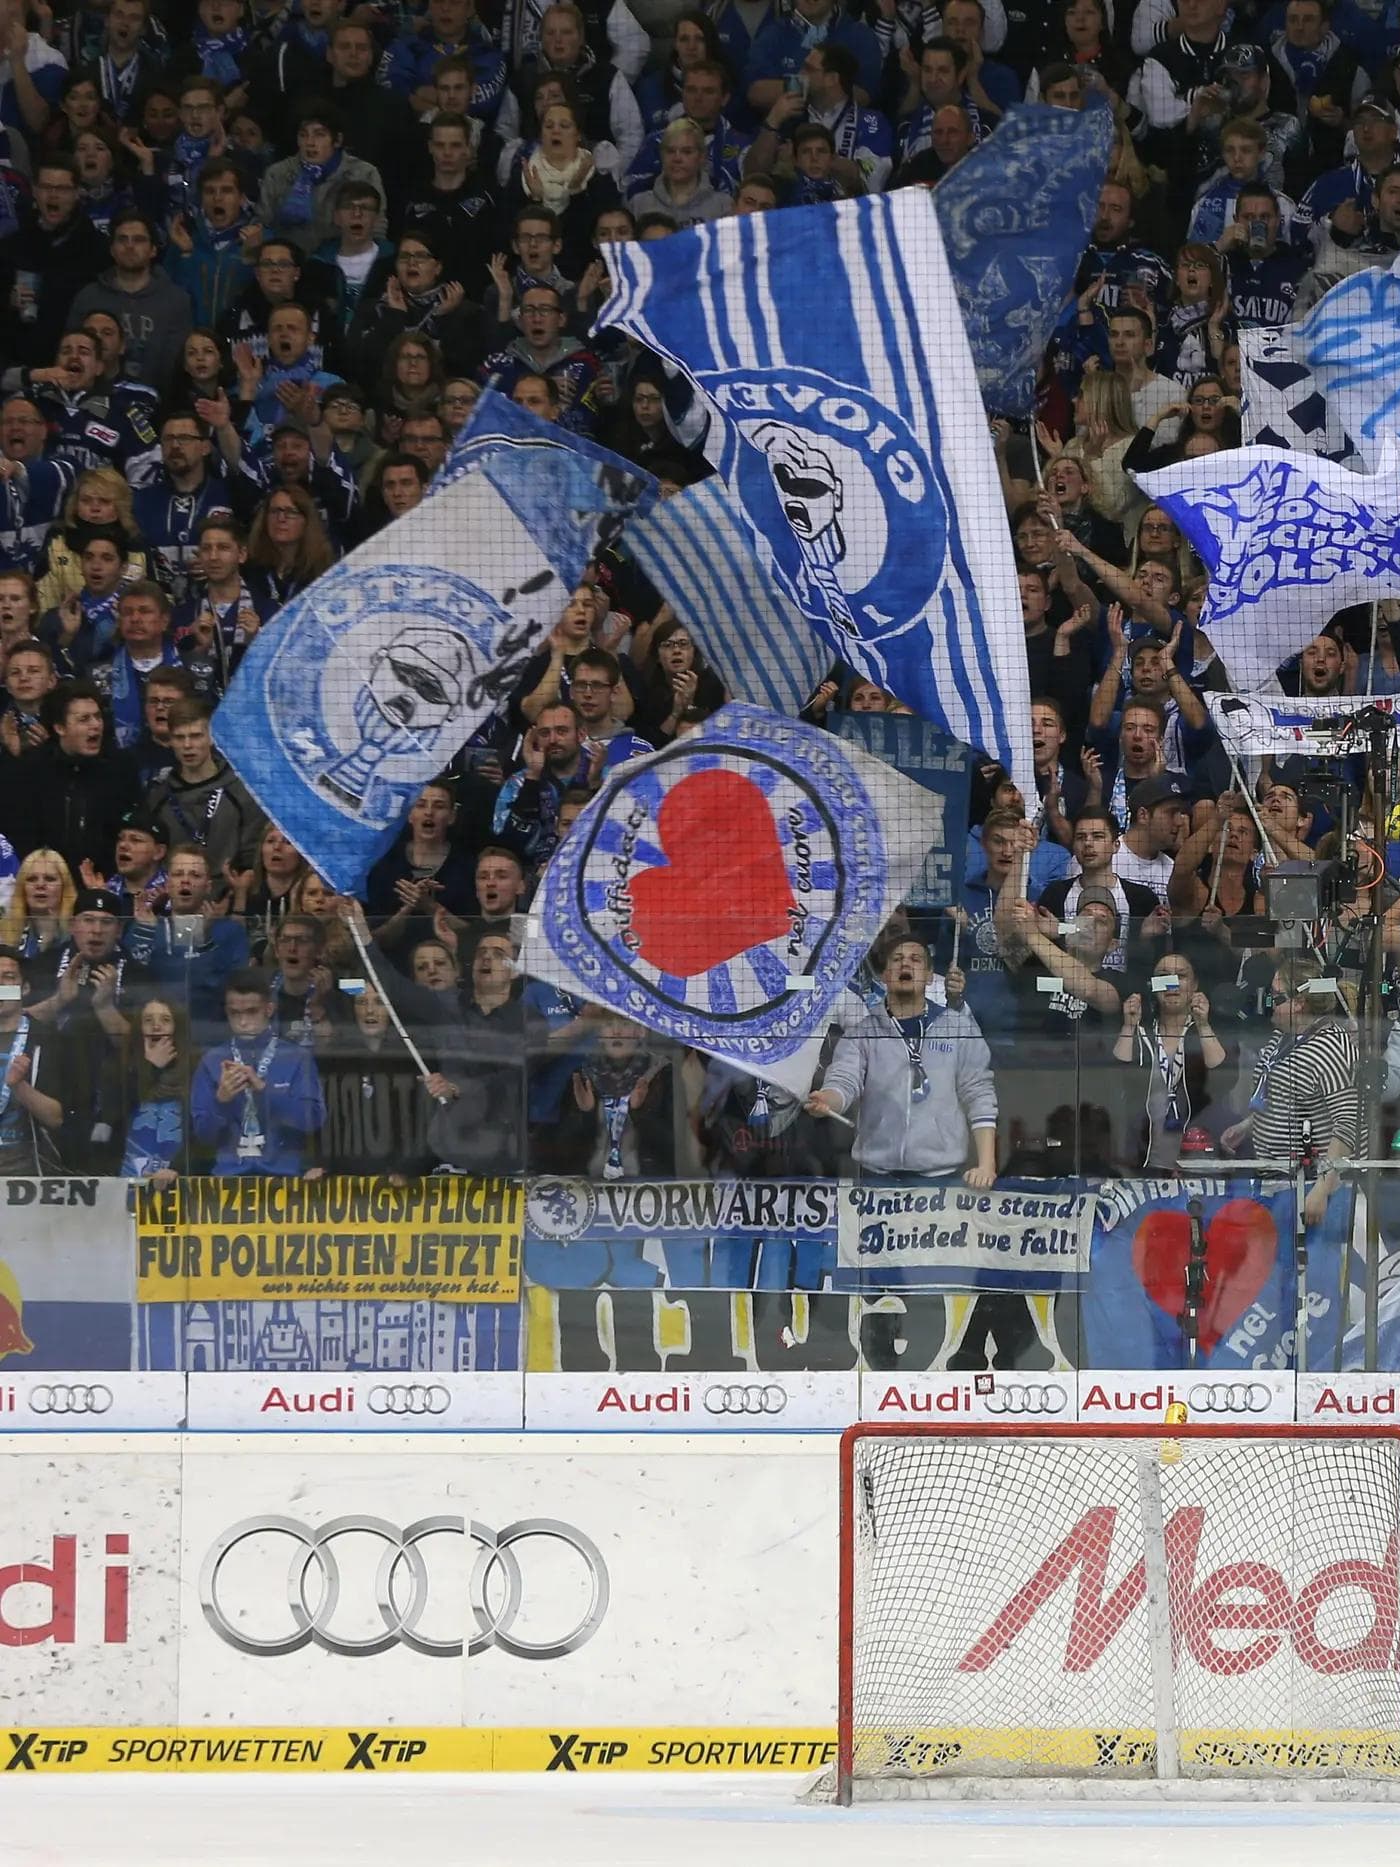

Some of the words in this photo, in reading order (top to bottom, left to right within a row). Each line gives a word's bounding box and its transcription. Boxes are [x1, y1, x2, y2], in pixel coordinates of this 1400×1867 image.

[139, 1175, 524, 1225] KENNZEICHNUNGSPFLICHT
[849, 1188, 947, 1217] United
[956, 1193, 991, 1212] we
[999, 1193, 1087, 1218] stand!
[139, 1225, 201, 1278] FÜR
[211, 1234, 397, 1278] POLIZISTEN
[402, 1234, 501, 1278] JETZT
[857, 1220, 969, 1255] Divided
[978, 1231, 1011, 1249] we
[1020, 1228, 1078, 1256] fall!
[1251, 1289, 1331, 1370] cuoe
[261, 1387, 355, 1412] Audi
[598, 1387, 690, 1412] Audi
[879, 1386, 971, 1412] Audi
[1083, 1384, 1174, 1411] Audi
[0, 1534, 130, 1647] di
[110, 1740, 322, 1761] SPORTWETTEN
[648, 1741, 858, 1766] SPORTWETTE
[1096, 1734, 1159, 1767] X-Ti
